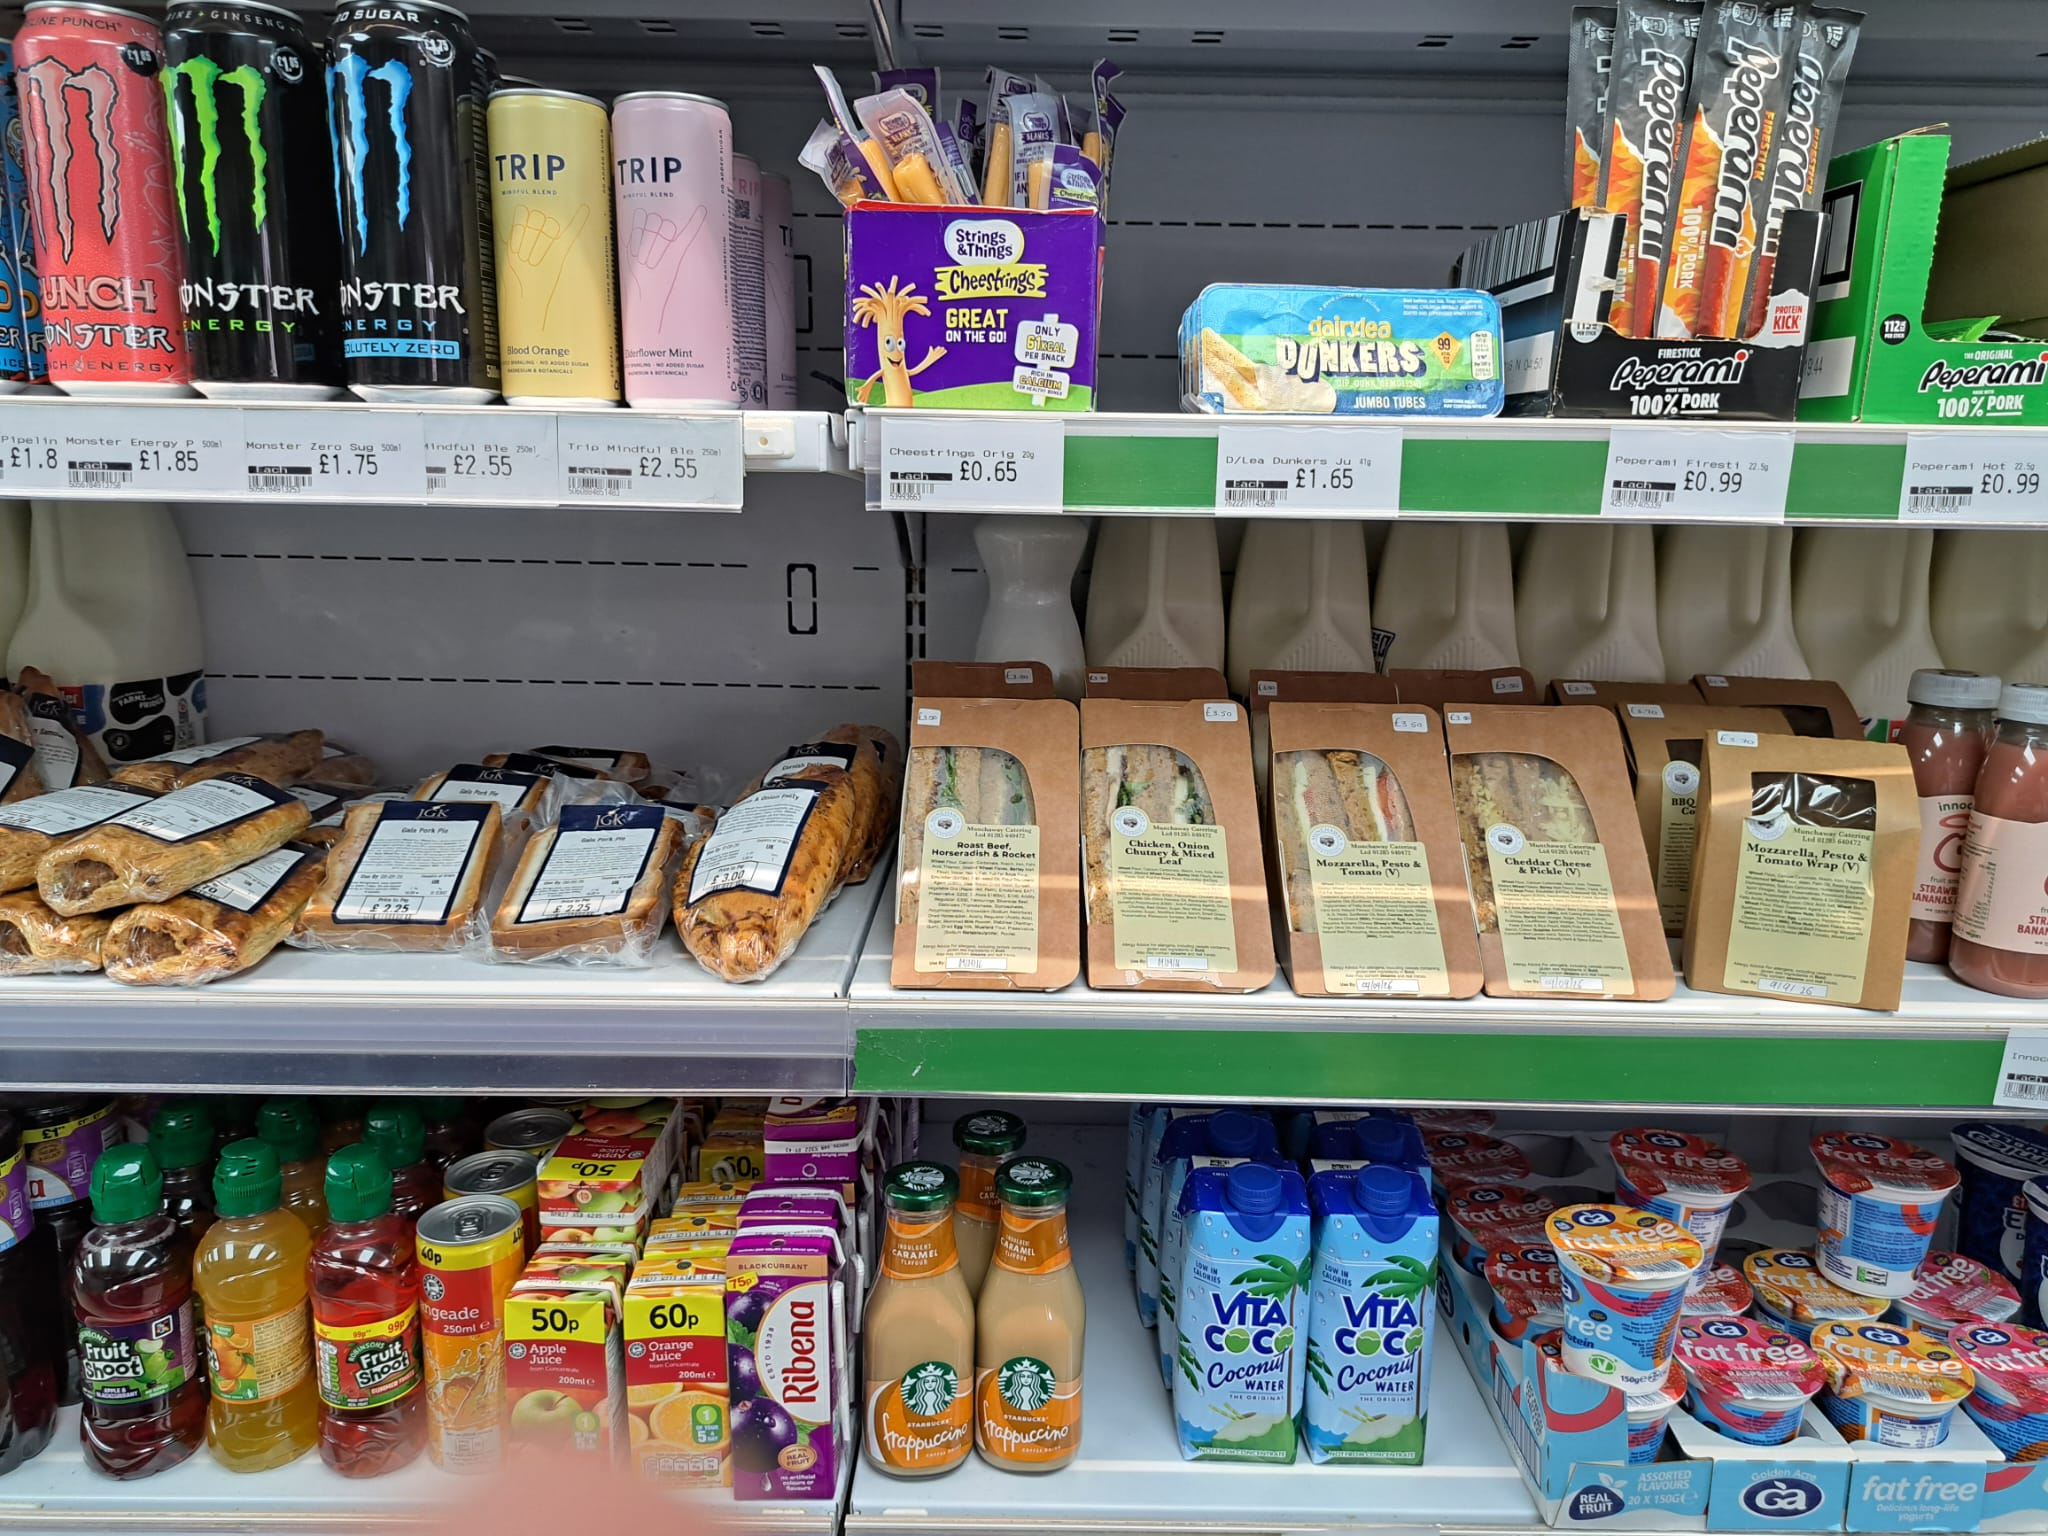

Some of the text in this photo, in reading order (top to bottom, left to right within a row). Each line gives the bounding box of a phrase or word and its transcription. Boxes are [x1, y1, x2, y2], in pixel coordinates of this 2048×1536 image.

[353, 9, 419, 23] SUGAR
[1752, 109, 1776, 182] FIRESTICK
[495, 153, 566, 182] TRIP
[617, 156, 683, 186] TRIP
[956, 228, 1007, 247] Strings
[949, 269, 1036, 295] Cheestrings
[1775, 305, 1803, 314] PROTEIN
[945, 307, 1008, 329] GREAT
[1034, 325, 1060, 337] ONLY
[1308, 316, 1391, 339] dairylea
[945, 331, 1007, 344] ON THE GO!
[1437, 338, 1451, 351] 99
[405, 342, 455, 355] ZERO
[531, 345, 570, 357] Orange
[668, 348, 693, 358] Mint
[1658, 347, 1702, 359] FIRESTICK
[1974, 350, 2013, 361] ORIGINAL
[1041, 352, 1065, 362] SNACK
[1276, 338, 1425, 383] DUNKERS
[1610, 350, 1746, 390] Peperami
[1918, 351, 2048, 393] Peperami
[1353, 396, 1426, 409] JUMBO TUBES
[1630, 393, 1721, 416] 100% PORK
[1937, 395, 2025, 418] 100% PORK
[65, 436, 178, 449] Monster Energy
[246, 441, 374, 453] Monster Zero Sug
[484, 443, 508, 453] Ble
[568, 442, 694, 455] Trip Mindful Ble
[889, 447, 1014, 459] Cheestrings Orig
[139, 450, 199, 471] £1.85
[319, 453, 378, 475] £1.75
[453, 455, 513, 477] £2.55
[1226, 455, 1327, 466] D/Lea Dunkers
[1615, 455, 1677, 467] Peperami
[1912, 462, 2006, 472] Peperami Hot
[640, 457, 698, 479] £2.55
[959, 460, 1017, 482] £0.65
[1295, 468, 1353, 489] £1.65
[1683, 470, 1743, 493] £0.99
[1980, 473, 2040, 495] £0.99
[1671, 797, 1695, 808] BBQ
[416, 805, 449, 819] JGK
[1838, 831, 1871, 840] Catering
[957, 841, 984, 849] Roast
[1128, 839, 1210, 850] Chicken, Onion
[931, 849, 1036, 858] Horseradish Rocket
[1125, 847, 1215, 858] Chutney Mixed
[1746, 842, 1868, 862] Mozzarella, Pesto &
[1159, 857, 1183, 865] Leaf
[1316, 859, 1410, 869] Mozzarella, Pesto
[1504, 857, 1592, 867] Cheddar Cheese
[1755, 854, 1860, 873] Tomato Wrap (V)
[721, 869, 745, 882] 3.00
[1340, 867, 1382, 876] Tomato
[1530, 867, 1581, 878] Pickle (V)
[369, 903, 410, 914] £ 2.25
[1617, 1142, 1740, 1170] fat free
[1819, 1144, 1946, 1169] fat free
[571, 1162, 616, 1176] 50p
[1500, 1198, 1557, 1219] free
[1559, 1222, 1679, 1249] fat free
[1000, 1237, 1036, 1256] CARAMEL
[421, 1246, 442, 1265] 40p
[892, 1250, 938, 1259] CARAMEL
[738, 1263, 808, 1271] BLACKCURRANT
[1195, 1262, 1209, 1274] LOW
[1324, 1263, 1338, 1275] LOW
[1193, 1267, 1221, 1285] CALORIES
[1322, 1269, 1352, 1287] CALORIES
[729, 1277, 753, 1290] 75p
[650, 1303, 699, 1330] 60p
[1211, 1292, 1288, 1327] VITA
[1342, 1294, 1418, 1328] VITA
[388, 1320, 405, 1334] 99p
[532, 1308, 579, 1333] 50p
[443, 1324, 476, 1334] 250ml
[648, 1341, 694, 1353] Orange
[1204, 1325, 1295, 1355] COCO
[1334, 1326, 1424, 1356] COCO
[86, 1341, 130, 1360] Fruit
[360, 1341, 402, 1369] Fruit
[529, 1344, 567, 1356] Apple
[649, 1352, 681, 1362] Juice
[781, 1300, 819, 1404] Ribena
[1680, 1339, 1808, 1362] fat free
[1822, 1334, 1964, 1375] fat free
[529, 1354, 562, 1365] Juice
[85, 1360, 141, 1379] Shoot
[358, 1355, 408, 1386] Shoot
[1207, 1346, 1289, 1389] Coconut
[1337, 1349, 1419, 1392] Coconut
[558, 1376, 585, 1385] 200ml
[678, 1371, 706, 1380] 200ml
[1245, 1379, 1285, 1392] WATER
[1375, 1381, 1414, 1393] WATER
[984, 1400, 1070, 1452] frappuccino
[883, 1412, 968, 1461] frappuccino
[786, 1453, 804, 1461] REAL
[786, 1458, 810, 1467] FRUIT
[1638, 1470, 1692, 1483] ASSORTED
[1751, 1468, 1788, 1482] Golden
[1637, 1479, 1690, 1491] FLAVOURS
[1863, 1475, 1978, 1502] fat free
[1579, 1493, 1611, 1504] REAL
[1579, 1502, 1613, 1514] FRUIT
